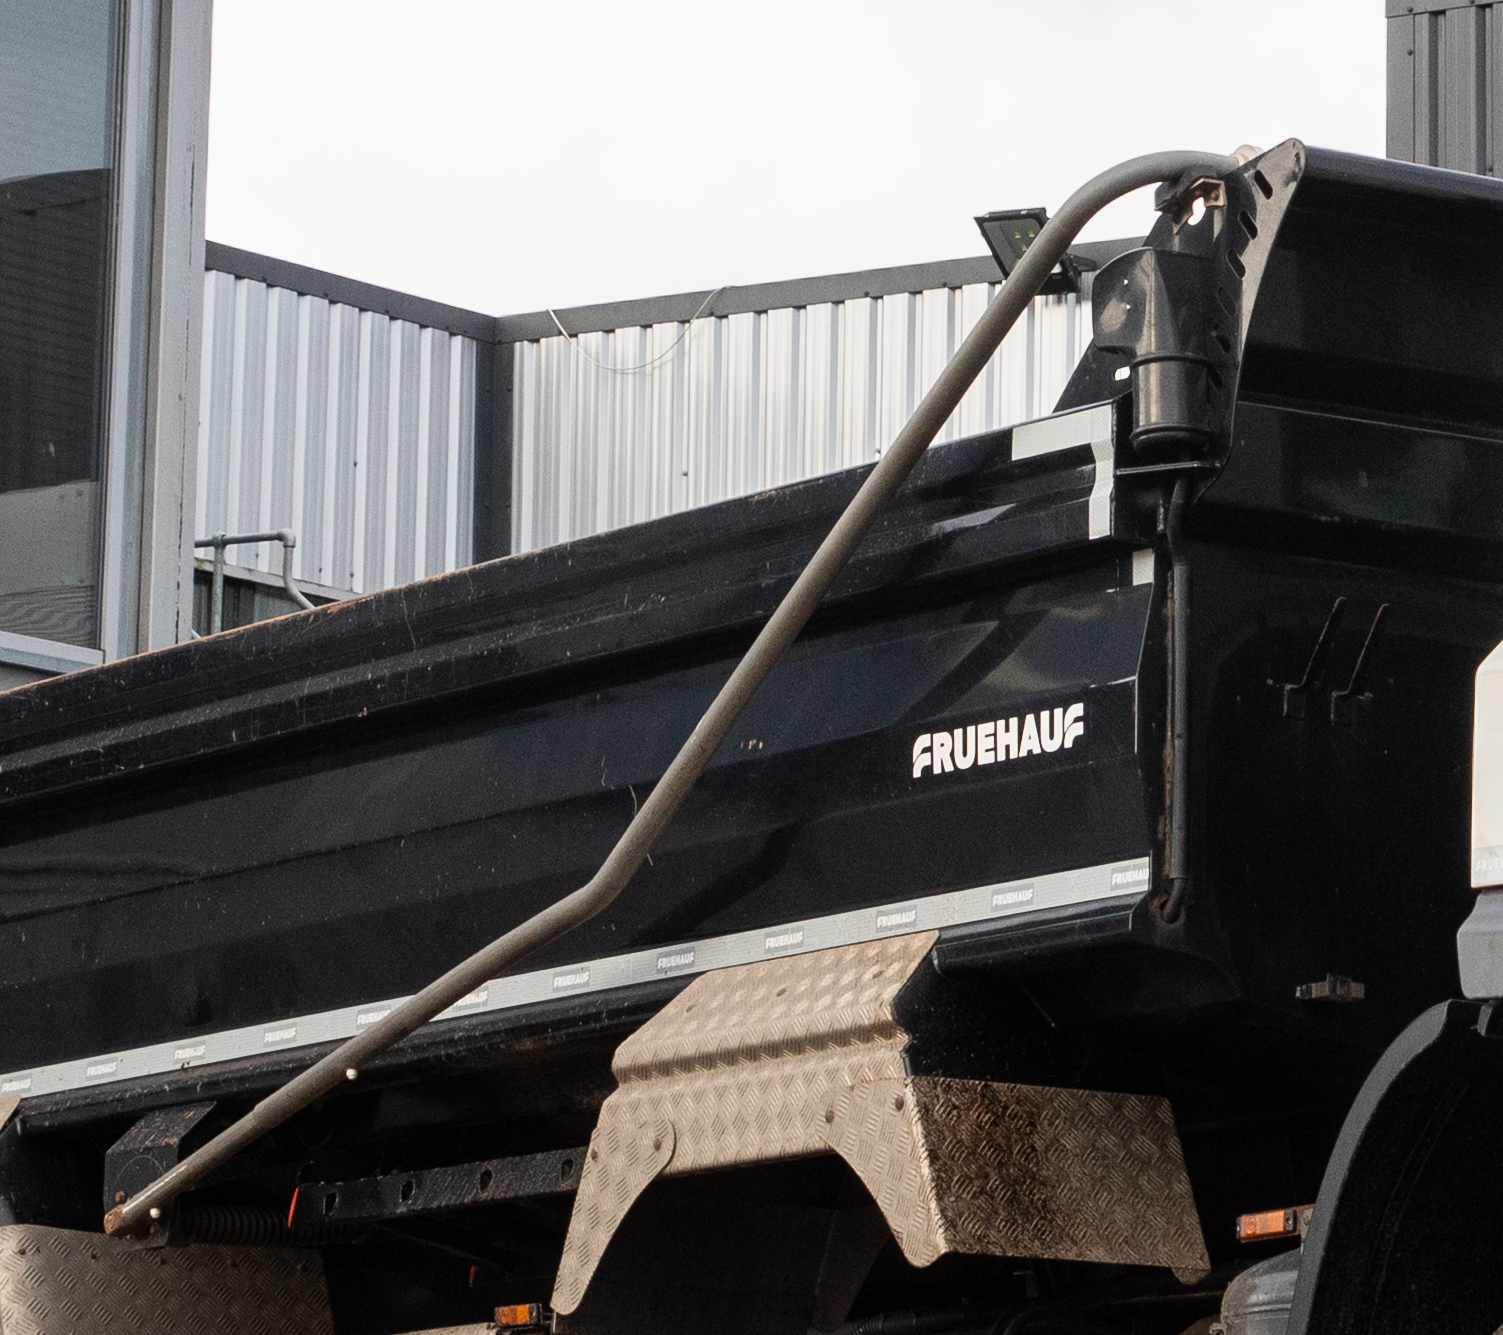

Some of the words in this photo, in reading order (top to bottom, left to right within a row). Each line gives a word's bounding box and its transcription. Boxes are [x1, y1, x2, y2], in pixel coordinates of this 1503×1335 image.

[913, 702, 1084, 779] FRUEHAUF
[991, 888, 1034, 908] FRUEHAUF
[876, 910, 916, 929] FRUEHAUF
[765, 931, 804, 950] FRUEHAUF
[657, 952, 695, 970] FRUEHAUF
[553, 971, 590, 988] FRUEHAUF
